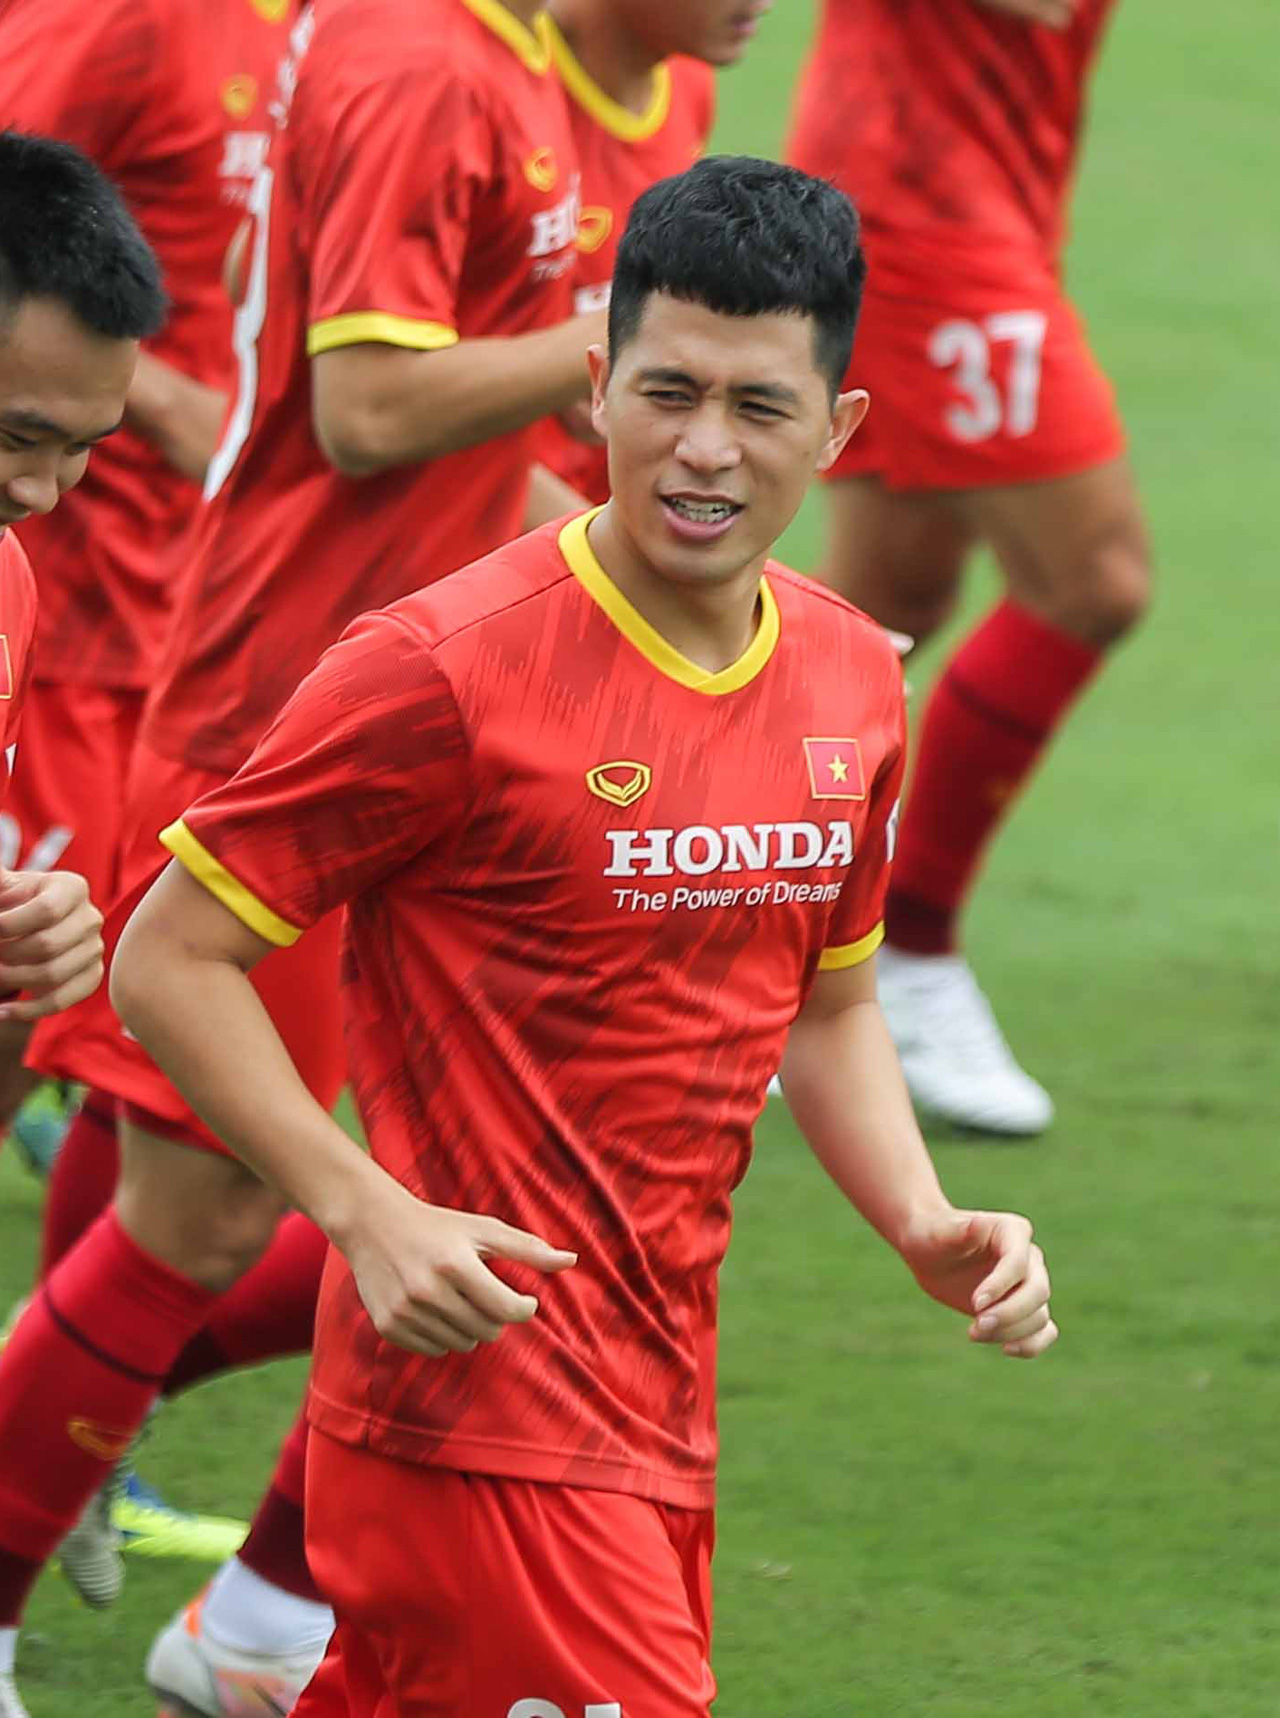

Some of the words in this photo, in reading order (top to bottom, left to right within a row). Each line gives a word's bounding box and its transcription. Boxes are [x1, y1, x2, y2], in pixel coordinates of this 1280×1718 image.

[927, 309, 1048, 443] 37
[603, 820, 855, 877] HONDA
[612, 888, 667, 912] The
[671, 885, 743, 911] Power
[745, 881, 772, 905] of
